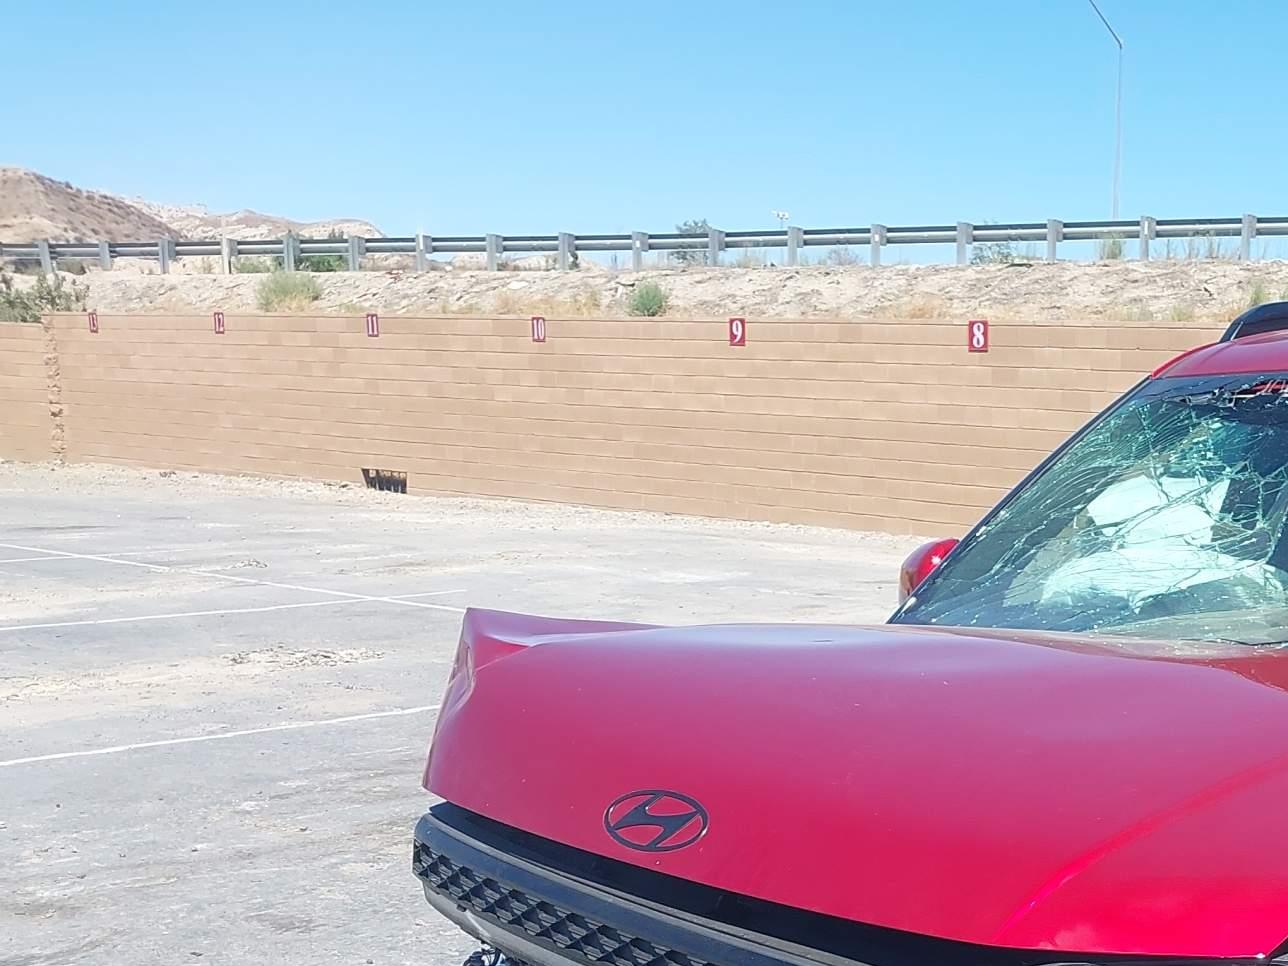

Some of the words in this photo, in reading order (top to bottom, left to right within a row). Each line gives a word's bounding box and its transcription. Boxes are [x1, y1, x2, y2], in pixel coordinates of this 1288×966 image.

[215, 314, 225, 331] 12
[367, 315, 379, 335] 11
[533, 319, 544, 340] 10
[732, 320, 743, 344] 9
[972, 322, 985, 348] 8
